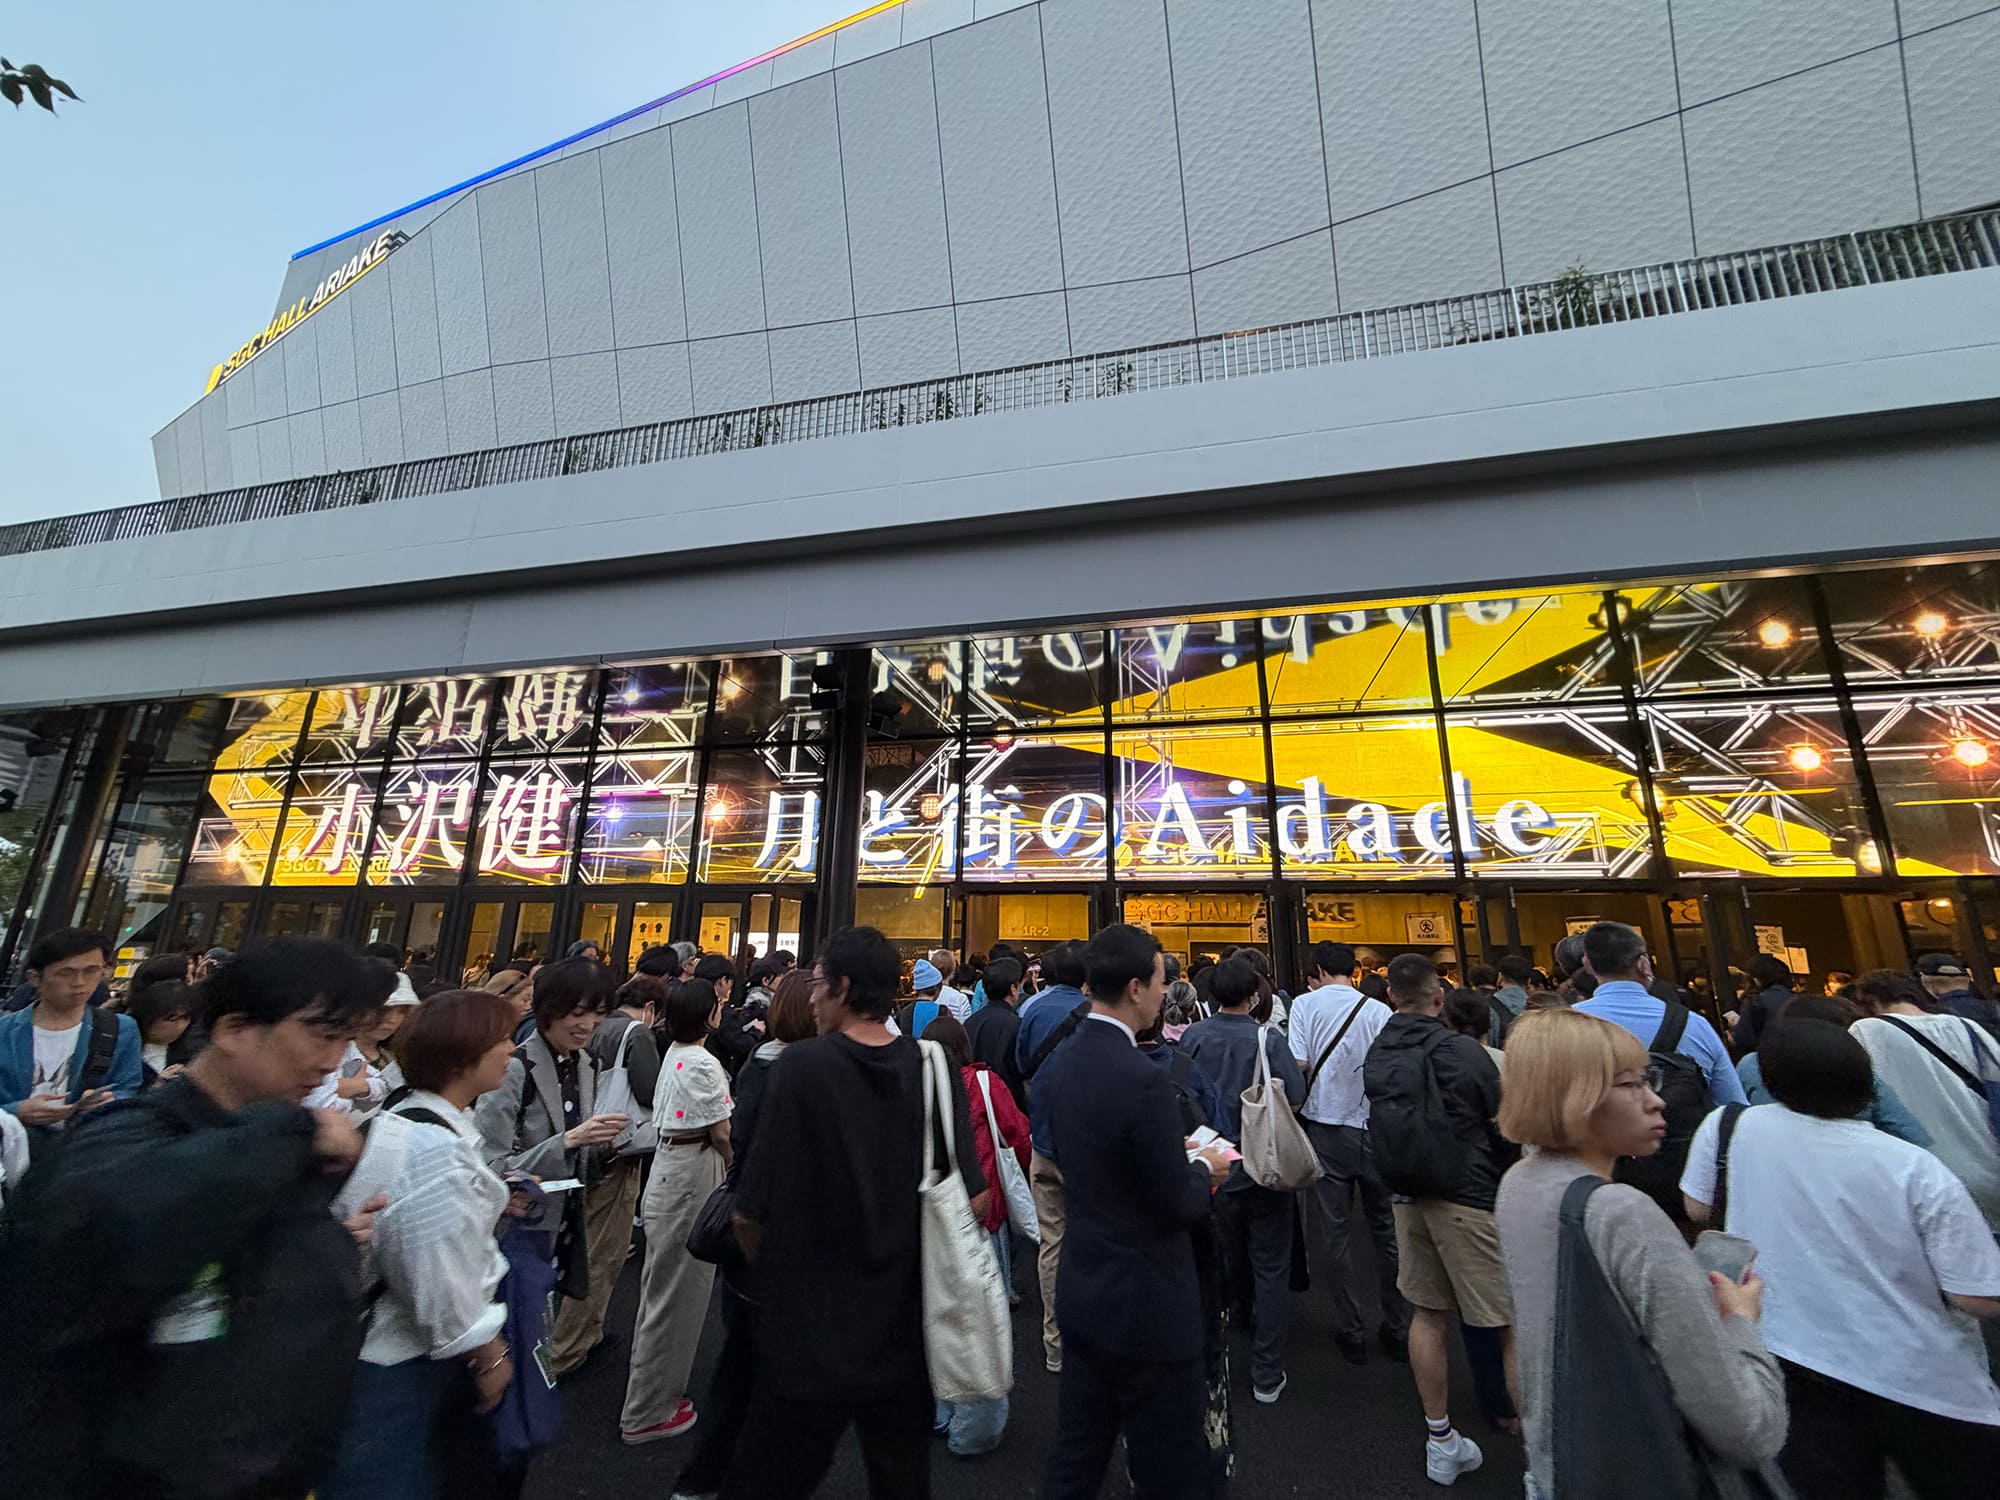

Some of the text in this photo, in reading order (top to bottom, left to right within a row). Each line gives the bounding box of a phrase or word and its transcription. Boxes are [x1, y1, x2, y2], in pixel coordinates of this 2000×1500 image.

[224, 229, 391, 375] SGC HALL ARIAKE
[1023, 926, 1049, 937] 1R-2
